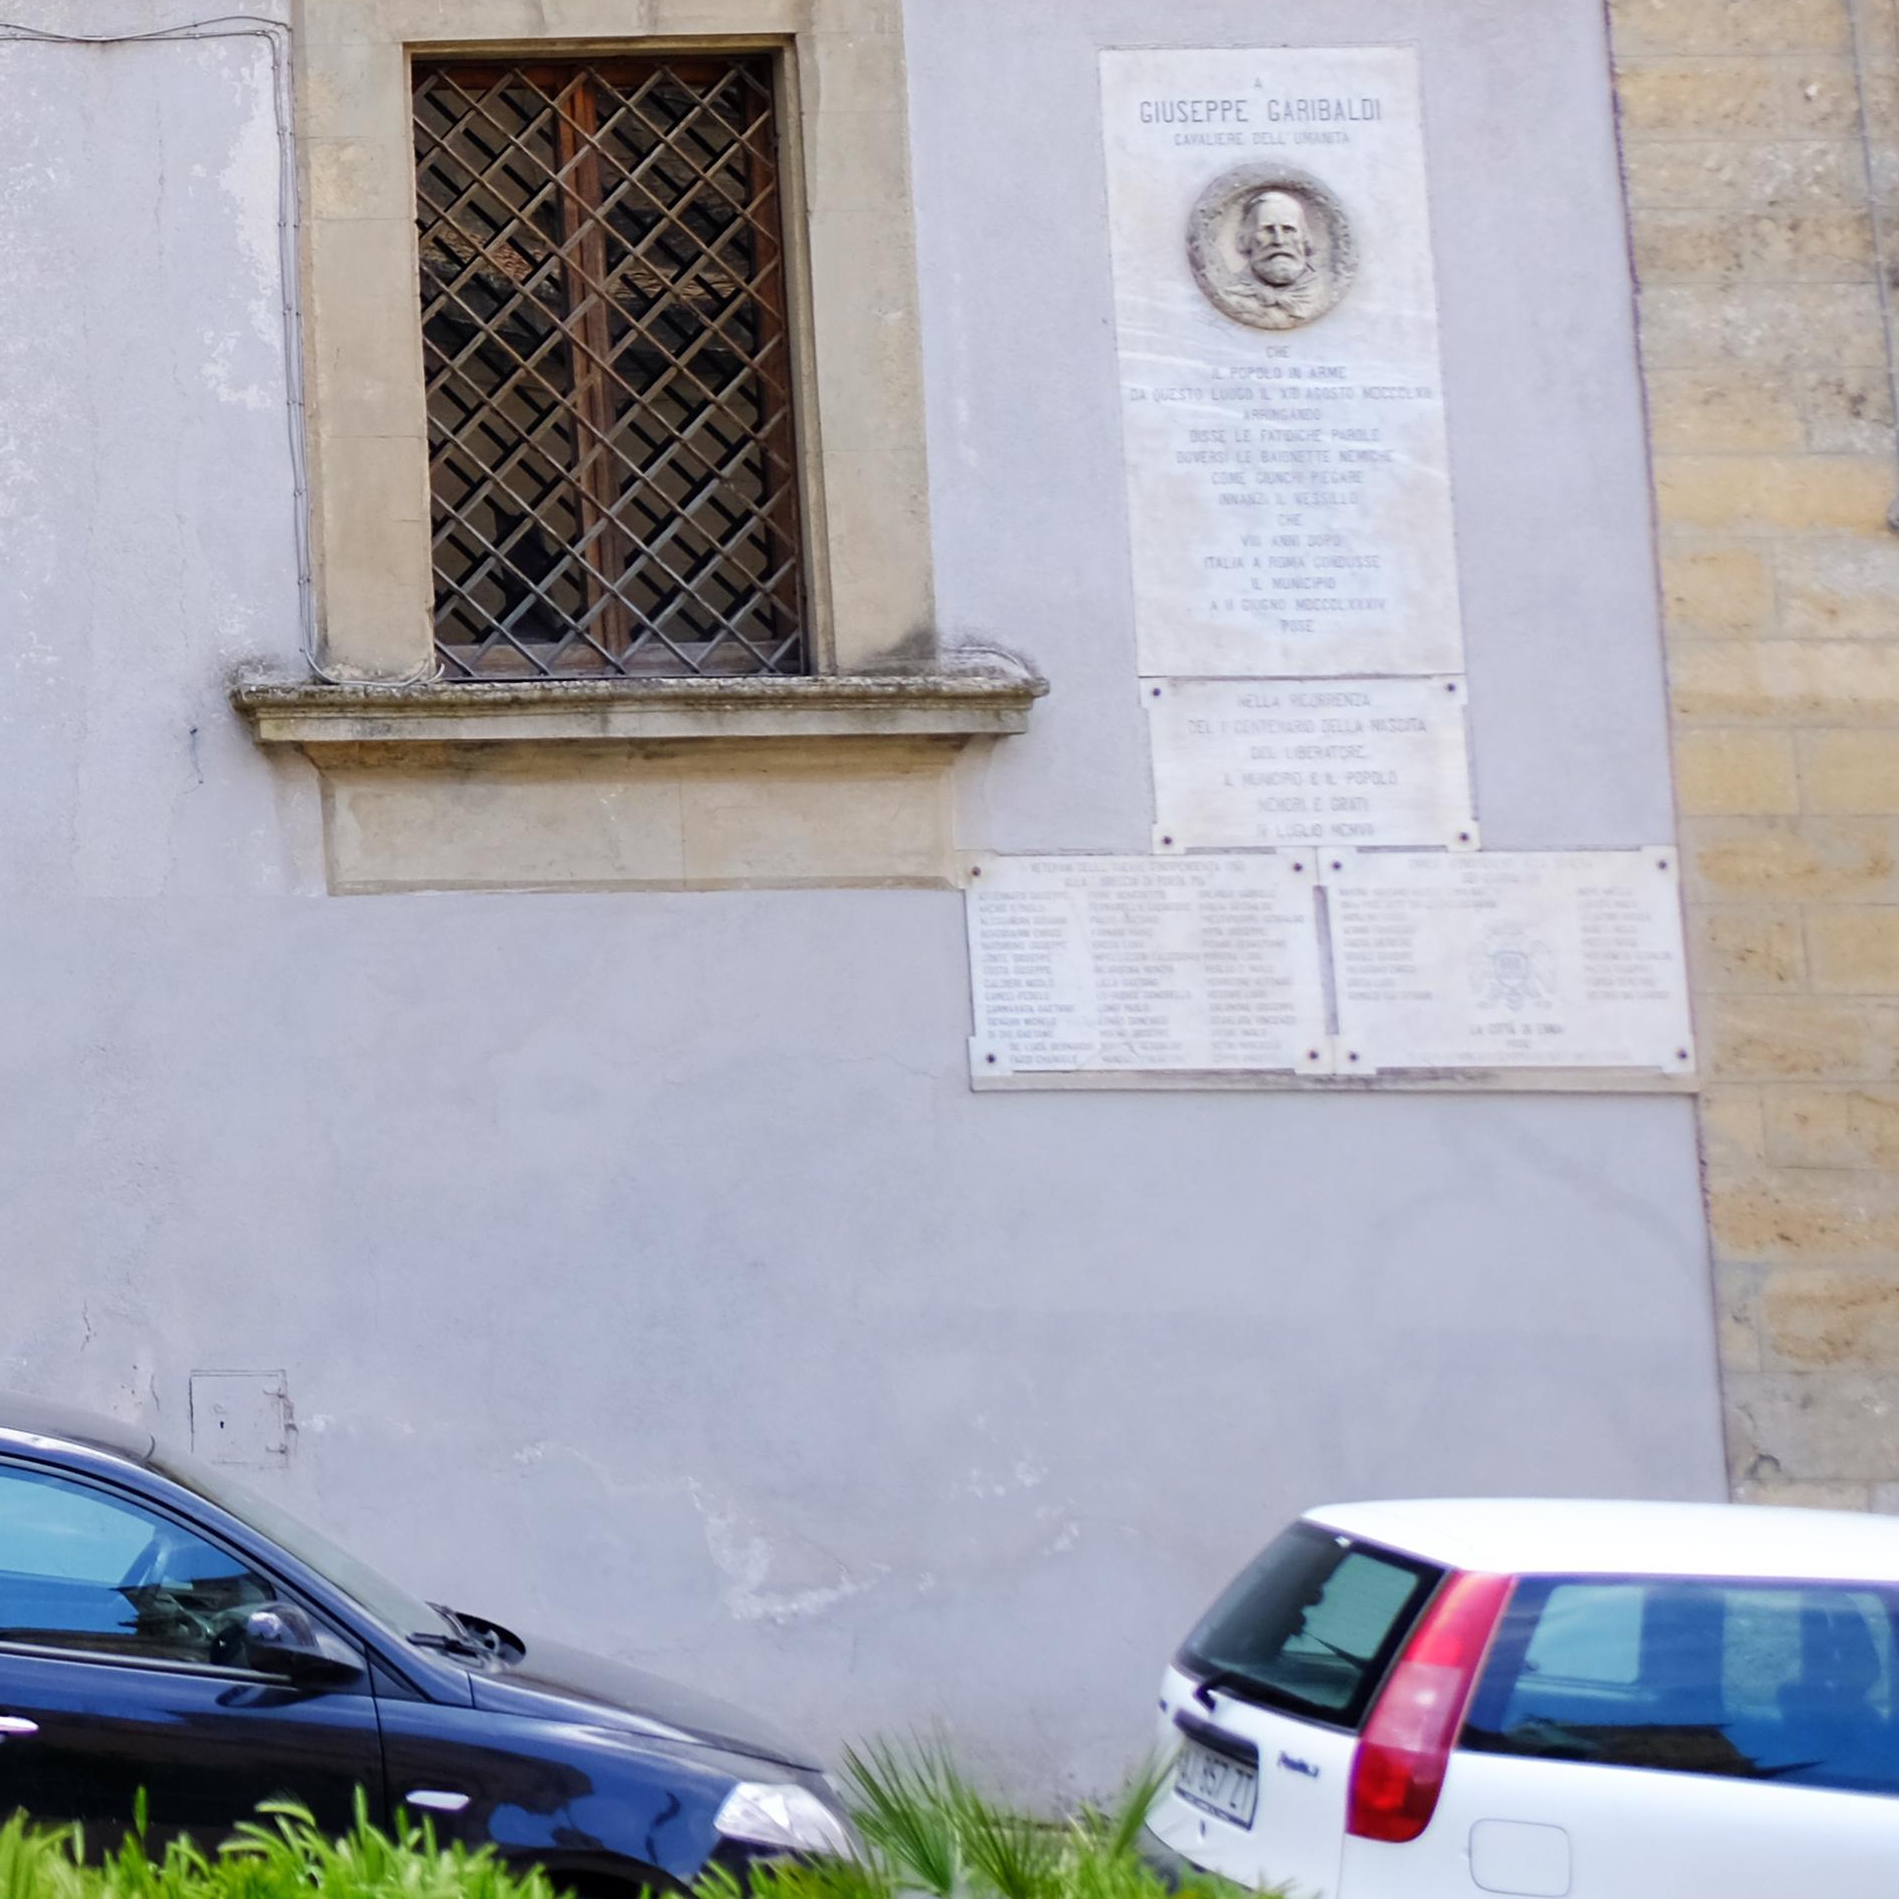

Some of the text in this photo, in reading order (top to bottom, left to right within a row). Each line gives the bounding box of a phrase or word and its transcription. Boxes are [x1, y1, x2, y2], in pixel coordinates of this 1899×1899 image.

[1253, 76, 1263, 89] A
[1139, 98, 1383, 124] GIUSEPPE GARIBALDI
[1173, 133, 1244, 146] CAVALIERE
[1265, 345, 1290, 358] CHE
[1230, 366, 1282, 379] POPOLO
[1309, 366, 1346, 379] ARME
[1130, 388, 1147, 401] DA
[1153, 387, 1202, 401] QUESTO
[1305, 386, 1354, 400] AGOSTO
[1189, 429, 1226, 443] DISSE
[1235, 429, 1251, 442] LE
[1331, 428, 1380, 441] PAROLE
[1236, 450, 1251, 463] LE
[1278, 513, 1303, 526] CHE
[1204, 556, 1244, 569] ITALIA
[1268, 556, 1306, 569] ROMA
